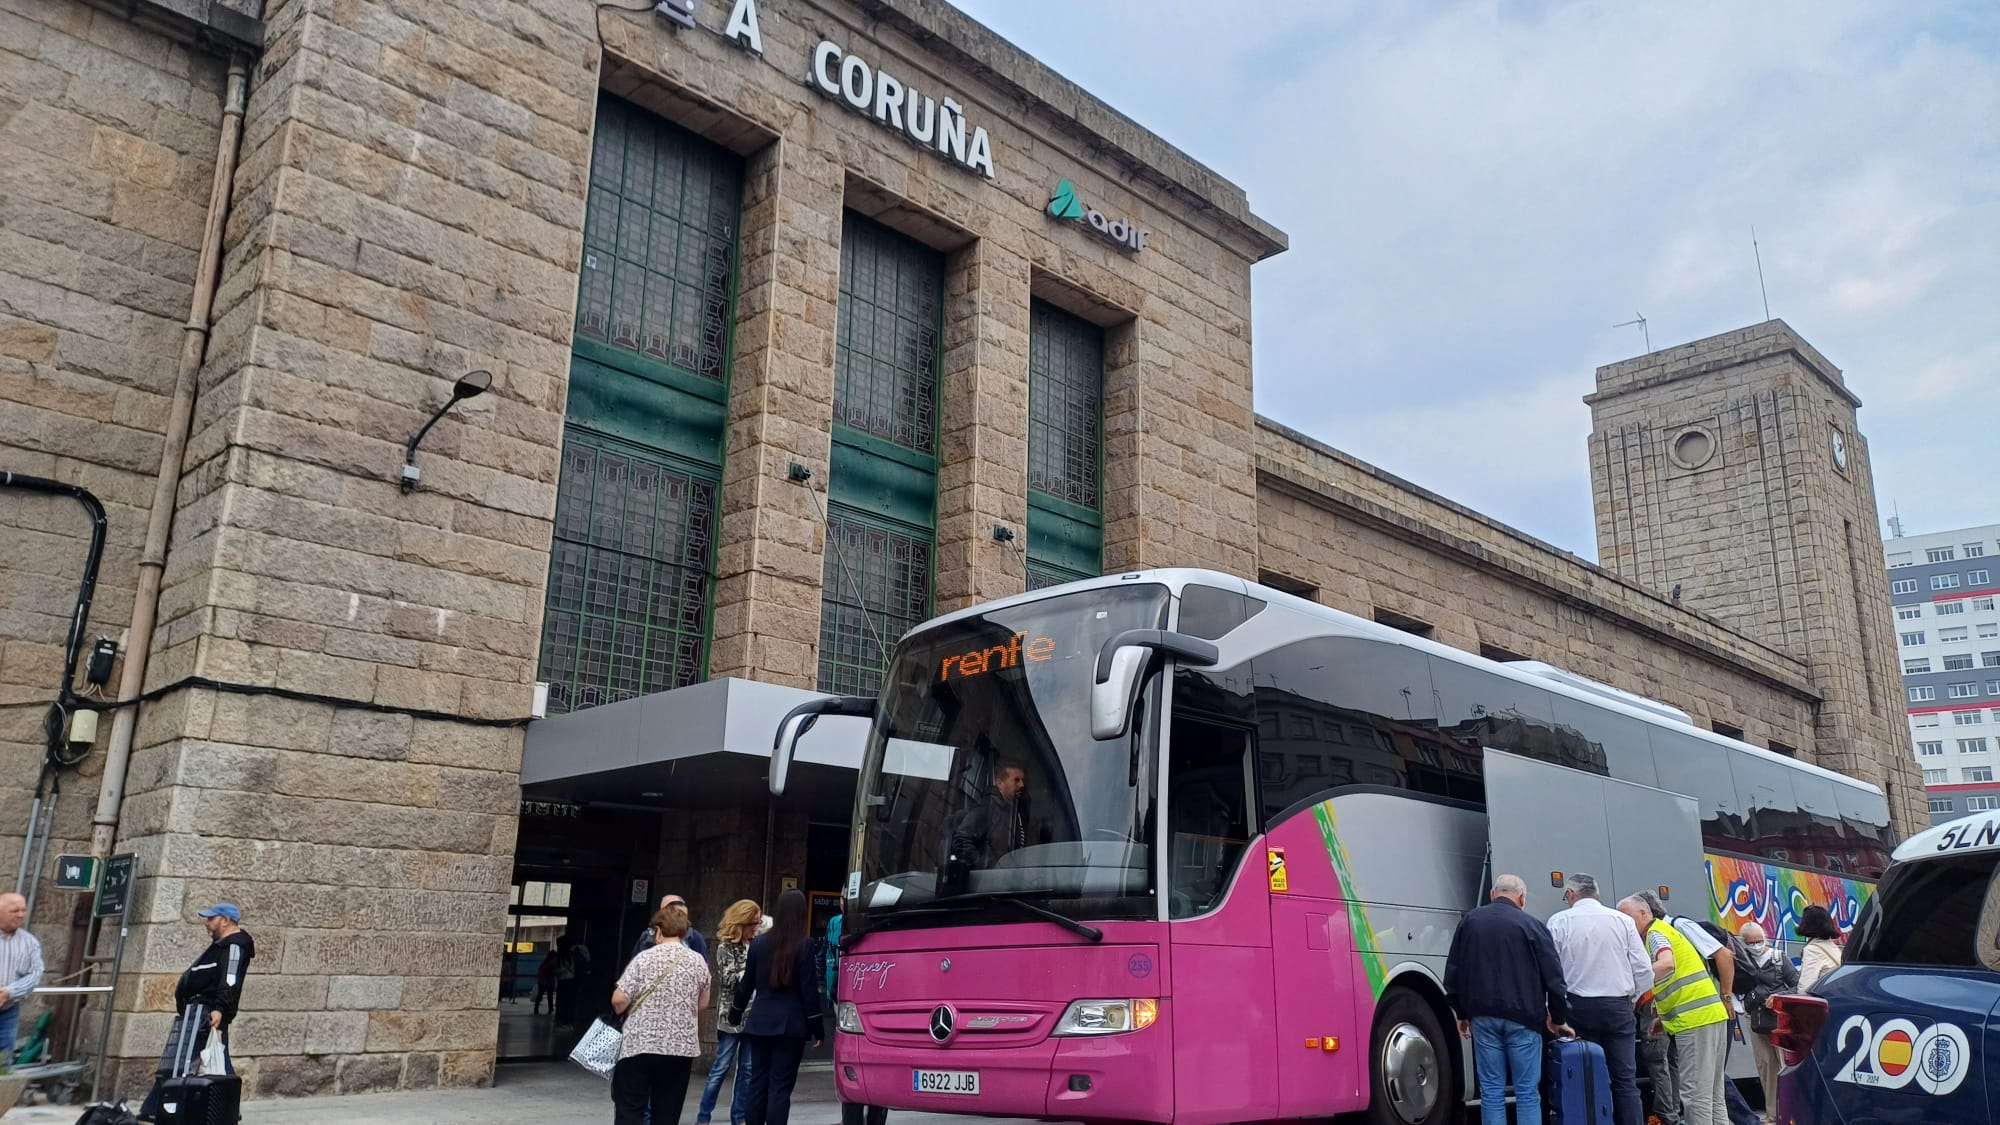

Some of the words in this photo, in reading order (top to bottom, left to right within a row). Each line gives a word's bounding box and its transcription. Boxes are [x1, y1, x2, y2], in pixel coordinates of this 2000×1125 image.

[724, 0, 763, 55] A
[813, 40, 996, 179] CORUÑA
[1087, 208, 1151, 251] adif
[942, 629, 1056, 681] renfe
[1130, 959, 1151, 972] 255
[1832, 1014, 1971, 1096] 200
[921, 1072, 951, 1091] 6922
[954, 1073, 975, 1092] JJB
